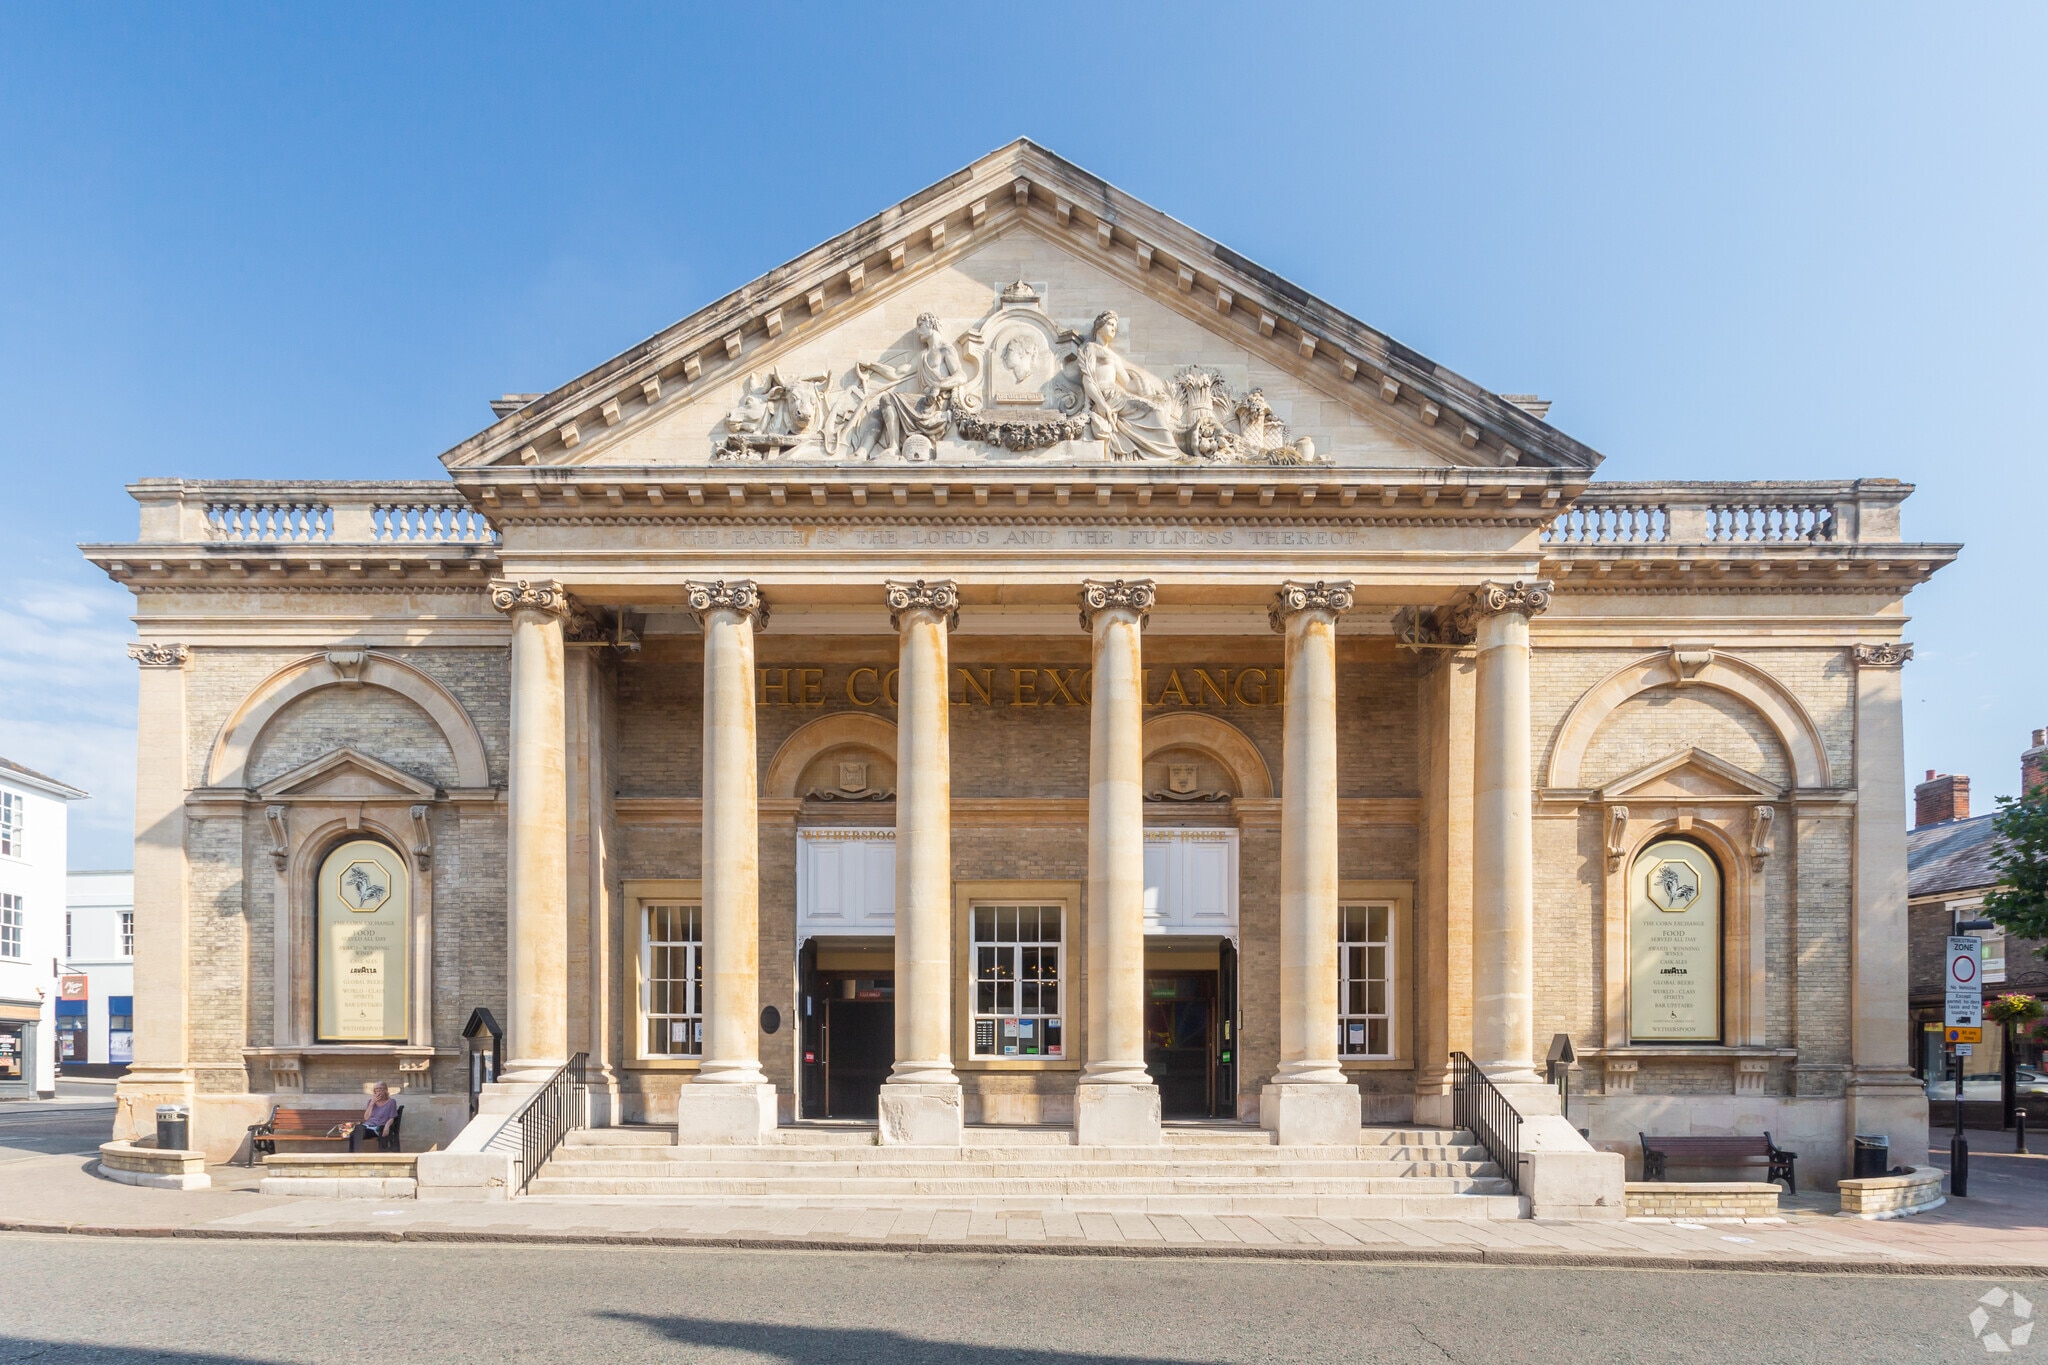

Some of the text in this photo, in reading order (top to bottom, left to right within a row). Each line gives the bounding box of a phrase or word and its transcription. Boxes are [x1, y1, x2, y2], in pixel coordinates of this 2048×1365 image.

[676, 530, 717, 545] THE
[731, 530, 804, 545] EARTH
[816, 530, 838, 545] IS
[853, 530, 898, 545] THE
[912, 529, 990, 545] LORD'S
[1003, 530, 1052, 545] AND
[1068, 530, 1113, 545] THE
[1129, 530, 1233, 545] FULNESS
[756, 668, 1285, 707] HE CN EXANG
[802, 830, 896, 840] WETHERSPOO
[1143, 831, 1226, 841] REE HOUSE
